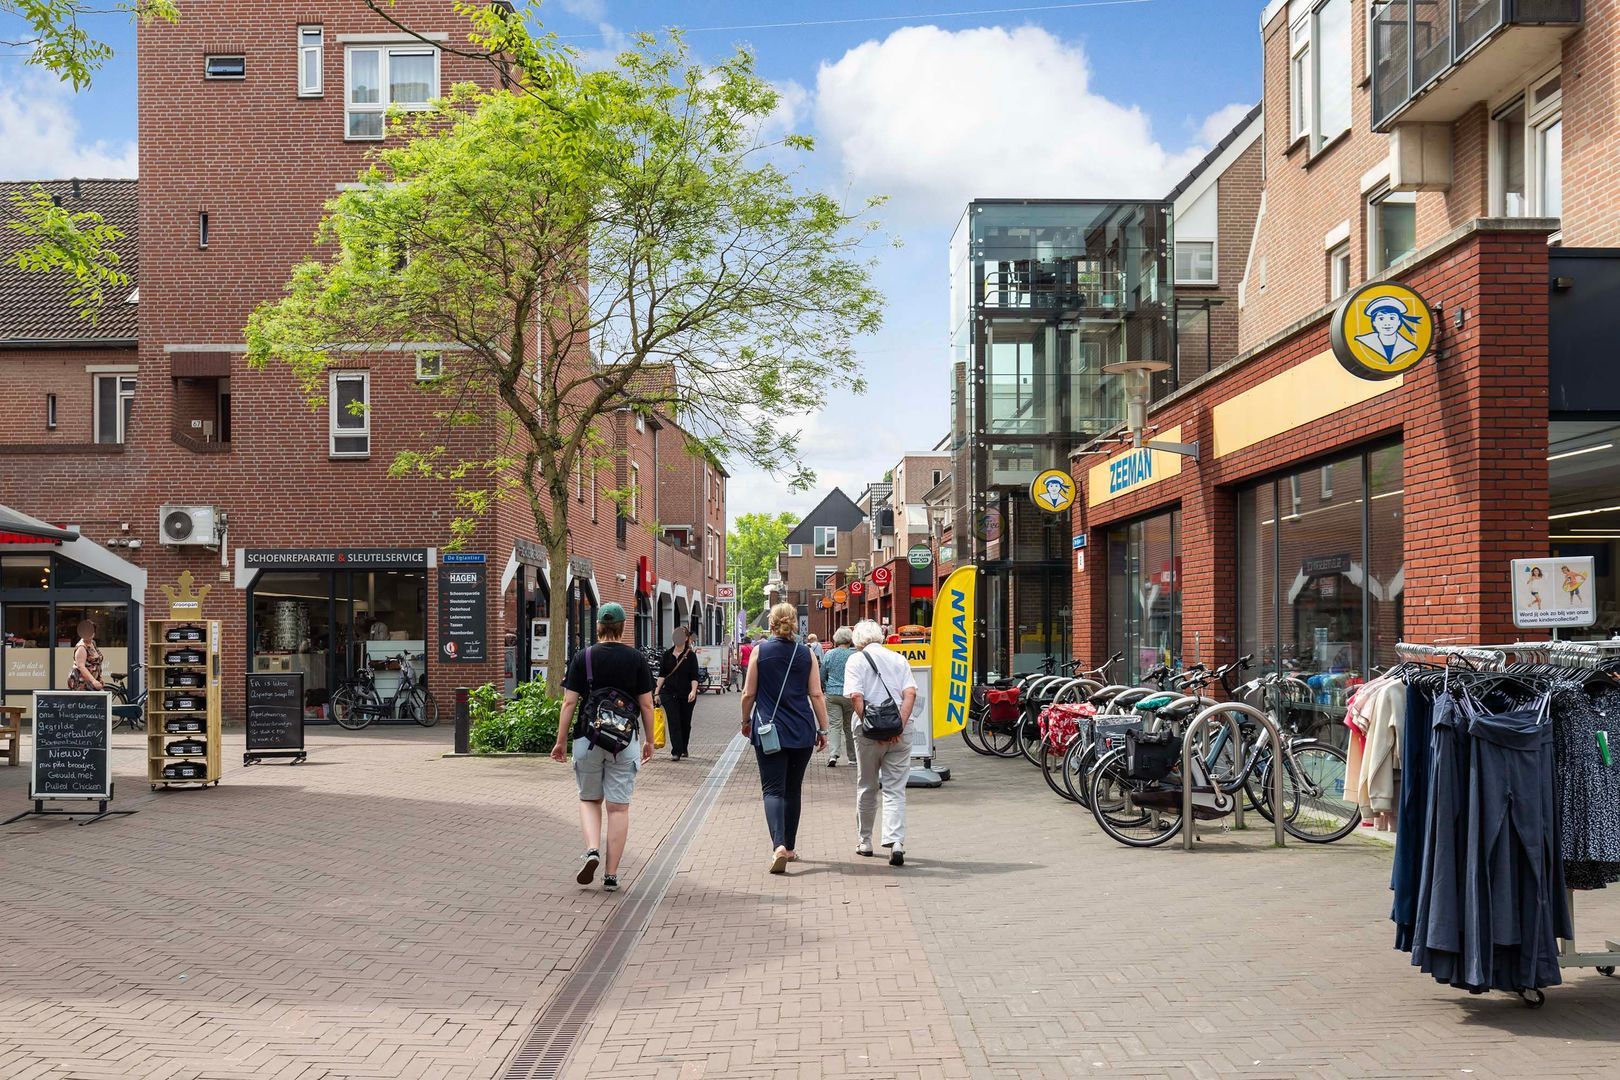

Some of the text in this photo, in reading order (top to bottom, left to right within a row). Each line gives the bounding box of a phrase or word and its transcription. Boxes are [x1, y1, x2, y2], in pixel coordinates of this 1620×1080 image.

[1110, 448, 1152, 494] ZEEMAN
[247, 553, 424, 564] SCHOENREPARATIE & SLEUTELSERVICE
[450, 574, 477, 582] HAGEN
[946, 589, 968, 726] ZEEMAN
[38, 700, 49, 708] Ze
